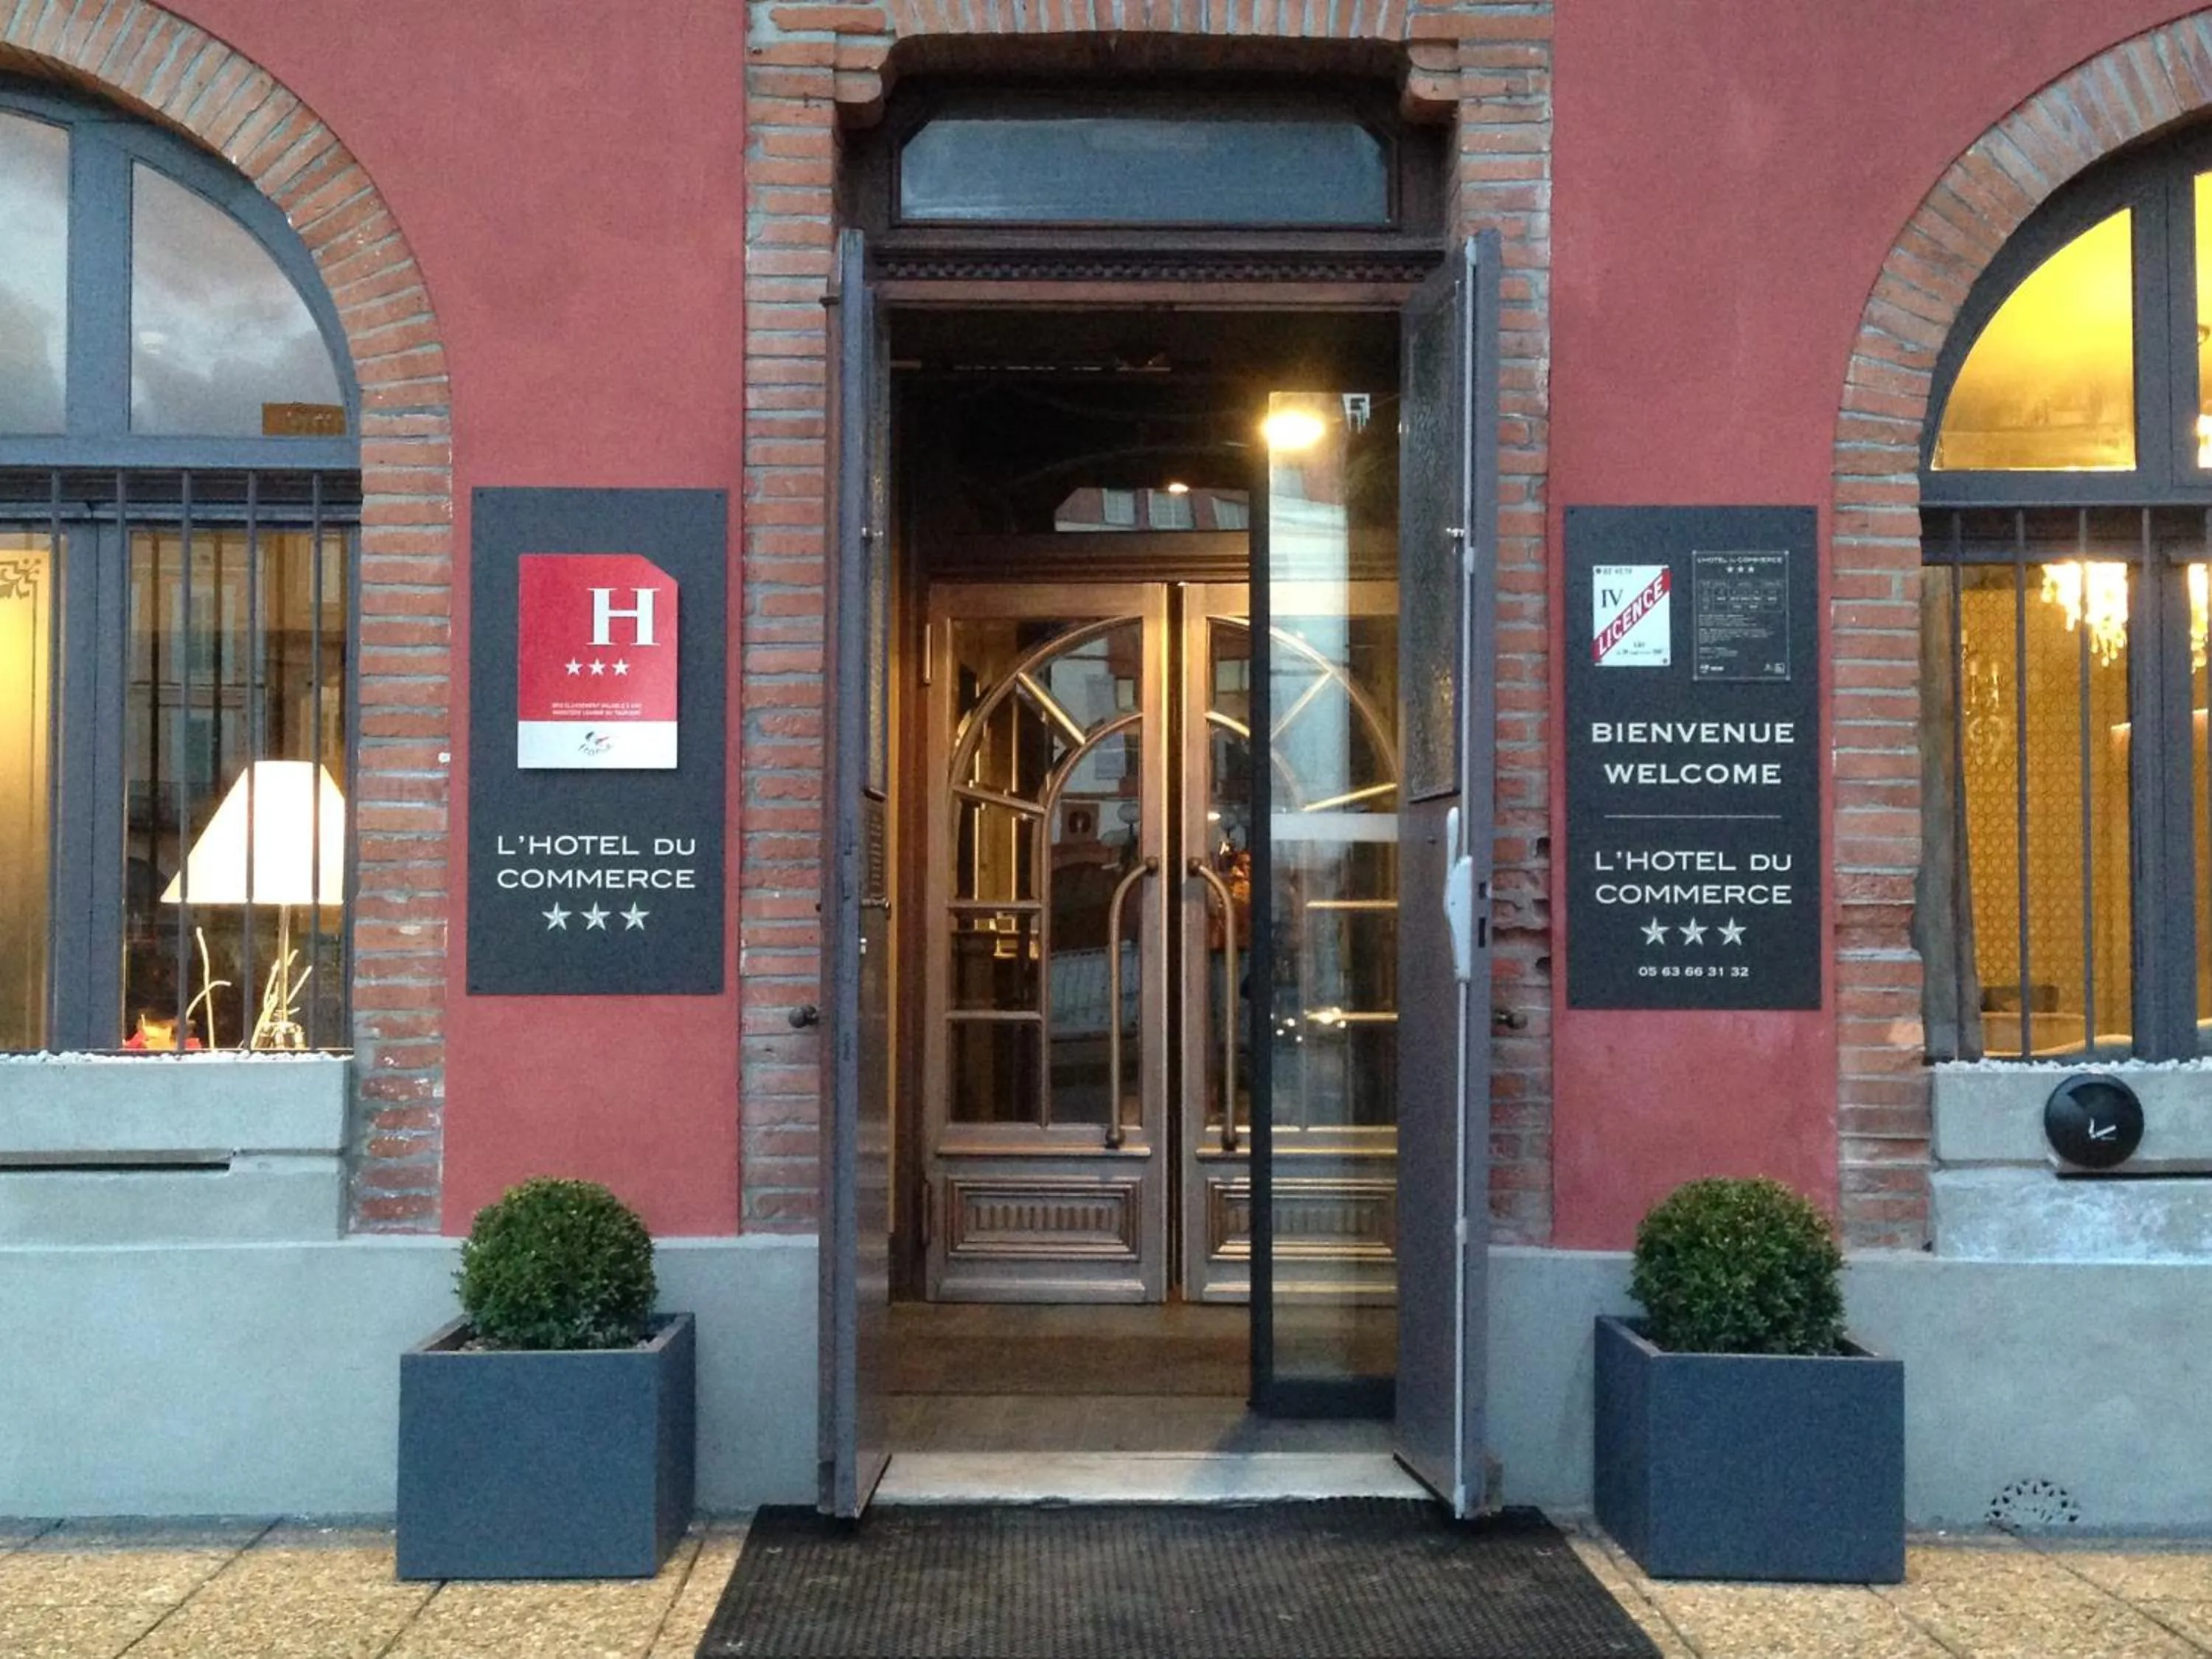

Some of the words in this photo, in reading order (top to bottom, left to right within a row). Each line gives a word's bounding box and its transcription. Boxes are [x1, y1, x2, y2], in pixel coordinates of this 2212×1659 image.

[1601, 589, 1623, 608] IV
[587, 588, 661, 646] H
[1598, 574, 1664, 656] LICENCE
[1592, 723, 1794, 743] BIENVENUE
[1604, 764, 1781, 784] WELCOME
[497, 835, 640, 856] L'HOTEL
[654, 838, 695, 855] DU
[1596, 851, 1736, 872] L'HOTEL
[1750, 854, 1792, 871] DU
[497, 869, 695, 889] COMMERCE
[1595, 884, 1792, 905] COMMERCE
[1638, 966, 1657, 977] 05
[1661, 966, 1680, 977] 63
[1685, 966, 1703, 977] 66
[1708, 966, 1723, 977] 31
[1731, 966, 1749, 977] 32
